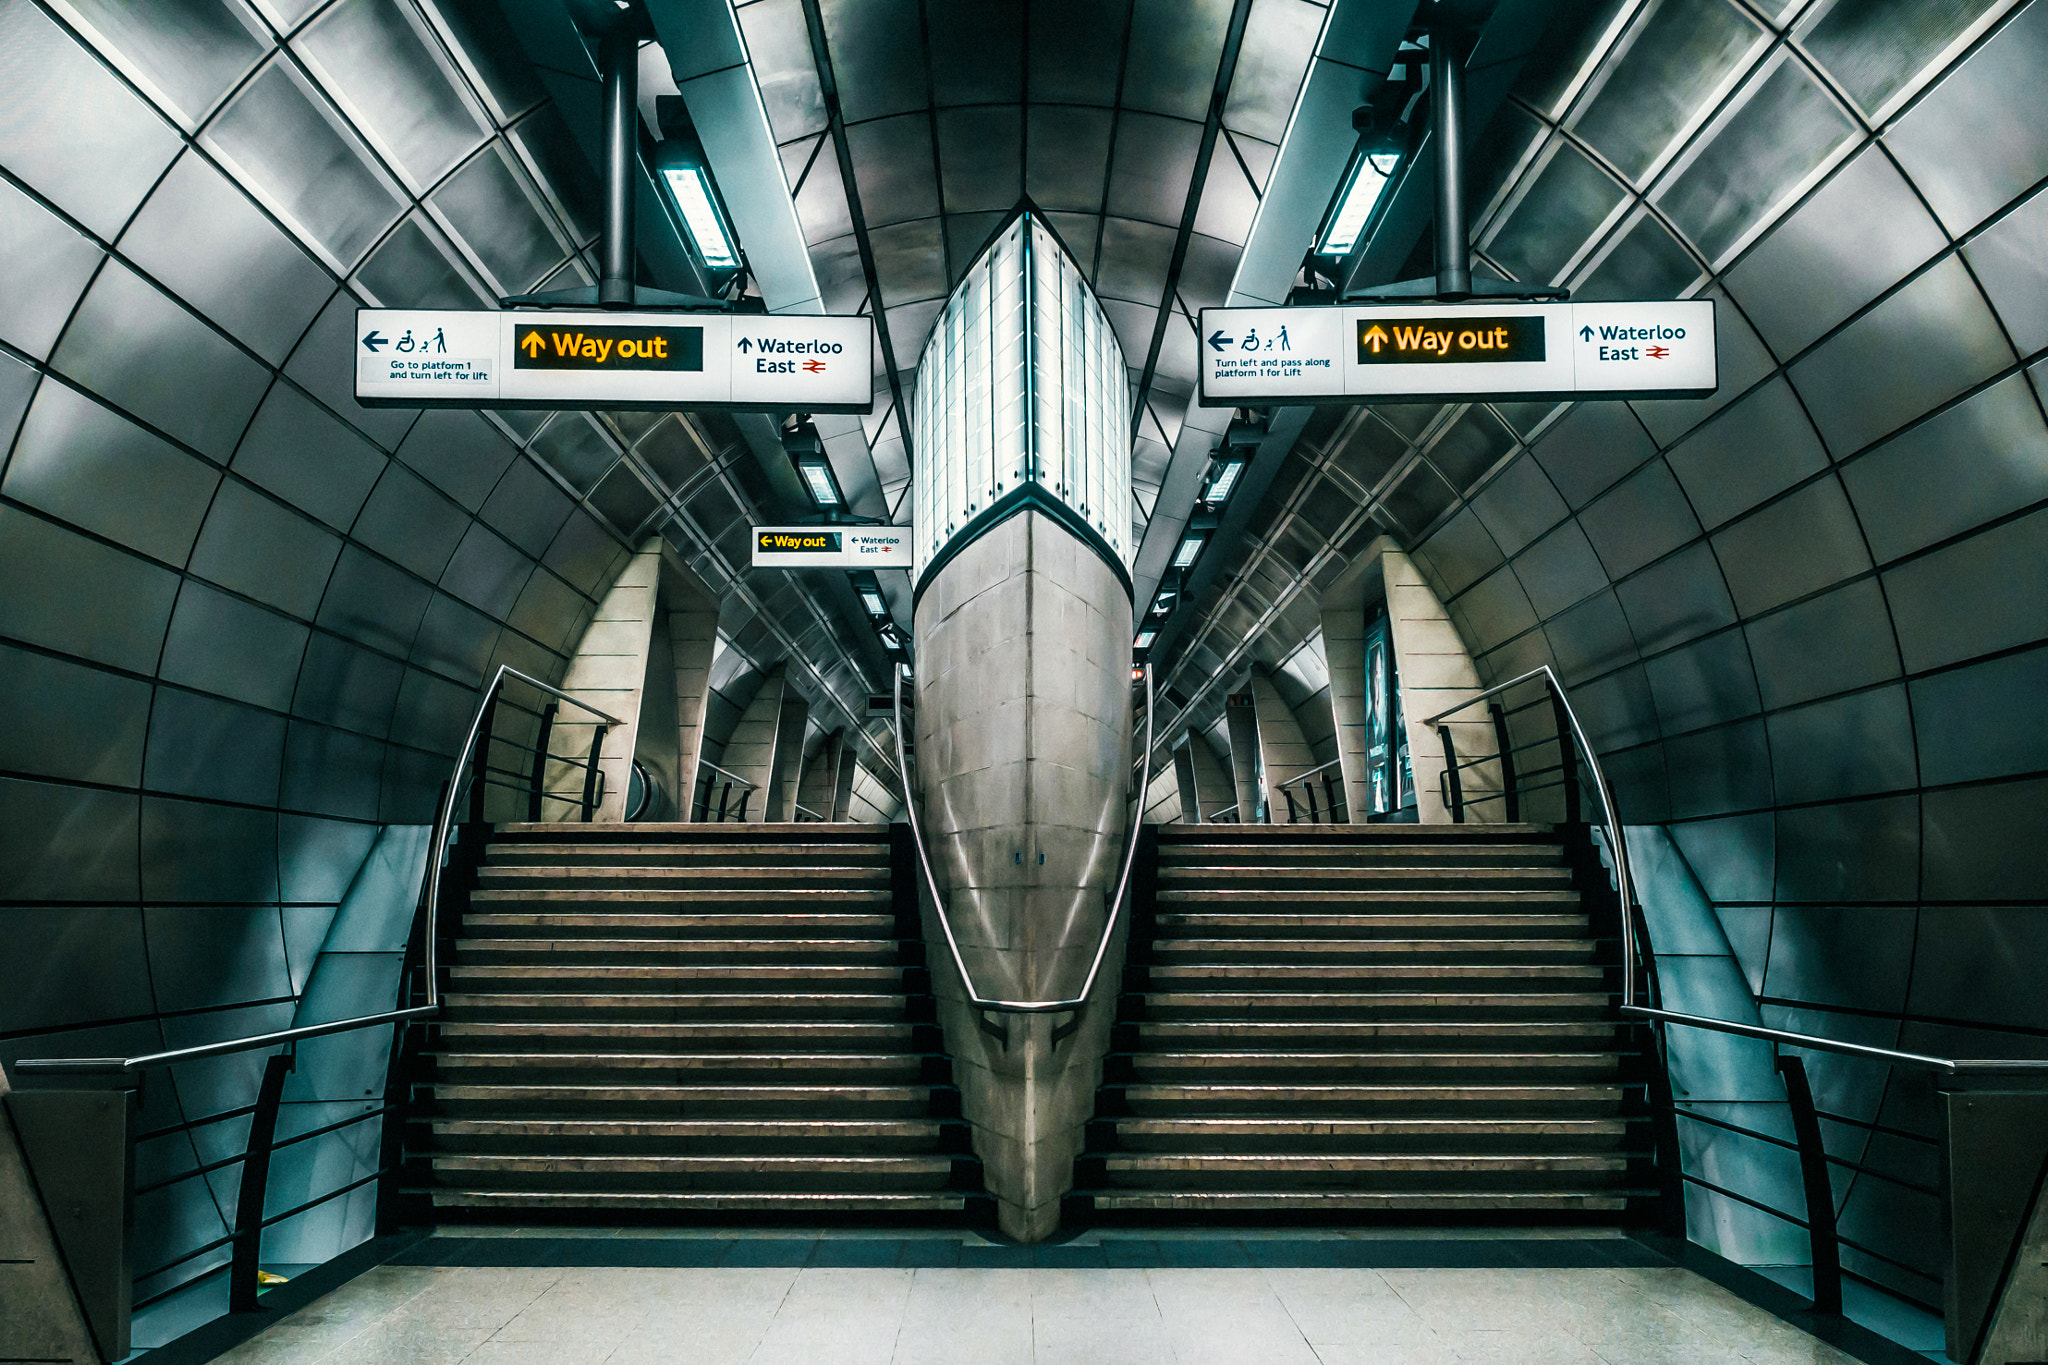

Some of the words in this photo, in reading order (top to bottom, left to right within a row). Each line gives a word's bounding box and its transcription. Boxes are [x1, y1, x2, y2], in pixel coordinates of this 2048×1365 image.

[1392, 326, 1454, 355] Way
[1458, 327, 1509, 350] out
[1598, 324, 1687, 342] Waterloo
[551, 332, 614, 362] Way
[616, 336, 668, 359] out
[757, 338, 843, 355] Waterloo
[1599, 346, 1639, 361] East
[390, 360, 405, 369] Go
[408, 361, 419, 369] to
[421, 361, 464, 371] platform
[466, 362, 471, 370] 1
[756, 358, 796, 374] East
[1215, 358, 1237, 368] Turn
[1239, 358, 1258, 367] left
[1260, 358, 1278, 367] and
[1281, 359, 1302, 368] pass
[1304, 358, 1331, 368] along
[389, 371, 408, 379] and
[410, 371, 432, 380] turn
[433, 371, 453, 380] left
[455, 371, 470, 380] for
[472, 371, 489, 381] lift
[1215, 369, 1257, 379] platform
[1259, 369, 1264, 377] 1
[1266, 368, 1281, 377] for
[1284, 368, 1301, 377] Lift
[774, 535, 802, 550] Way
[802, 536, 826, 547] out
[860, 536, 900, 545] Waterloo
[860, 545, 878, 554] East
